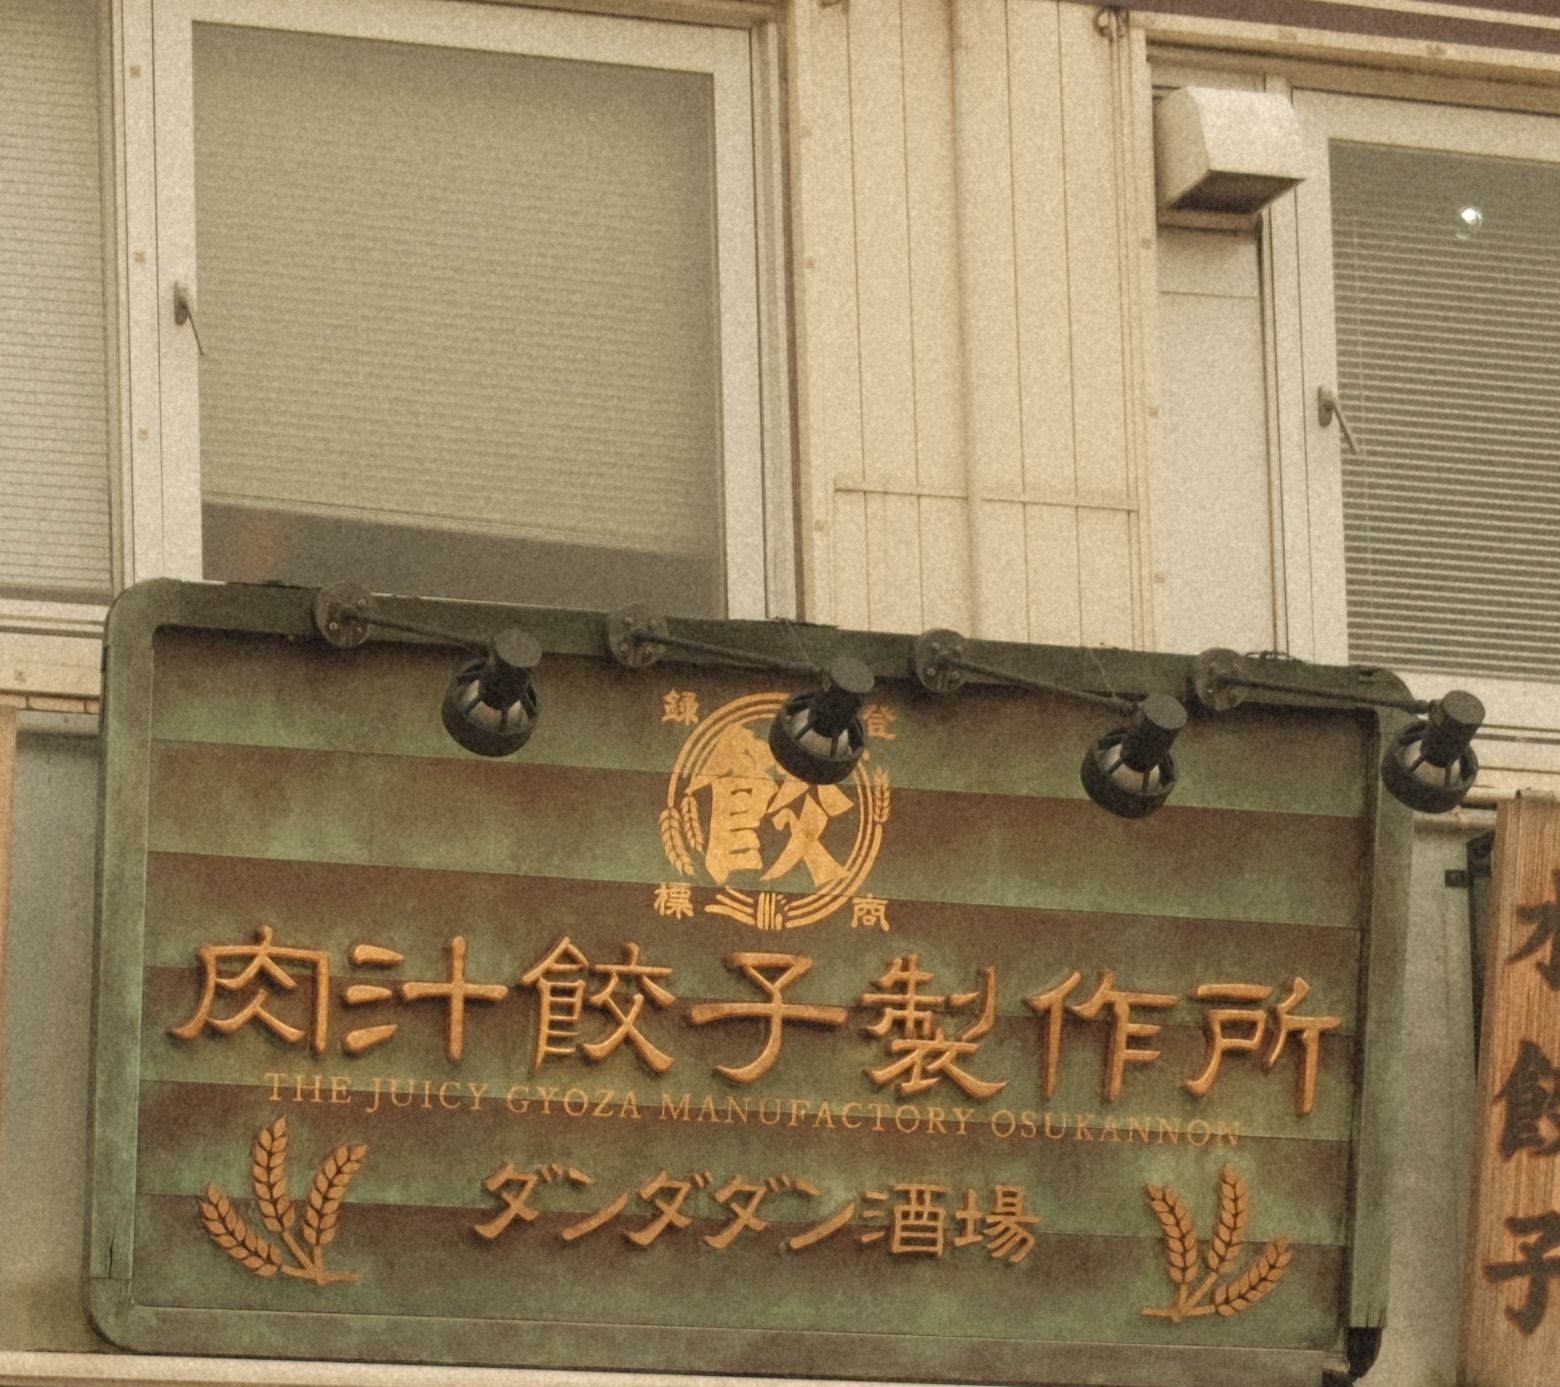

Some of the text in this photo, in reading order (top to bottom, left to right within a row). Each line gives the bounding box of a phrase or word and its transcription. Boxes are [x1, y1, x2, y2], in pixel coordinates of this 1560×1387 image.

[170, 926, 1342, 1114] 肉汁餃子製作所
[264, 1072, 1242, 1147] THE JUICY GYOZA MANUFACTORY OSUKANNON
[473, 1161, 1042, 1264] ダンダダン酒場
